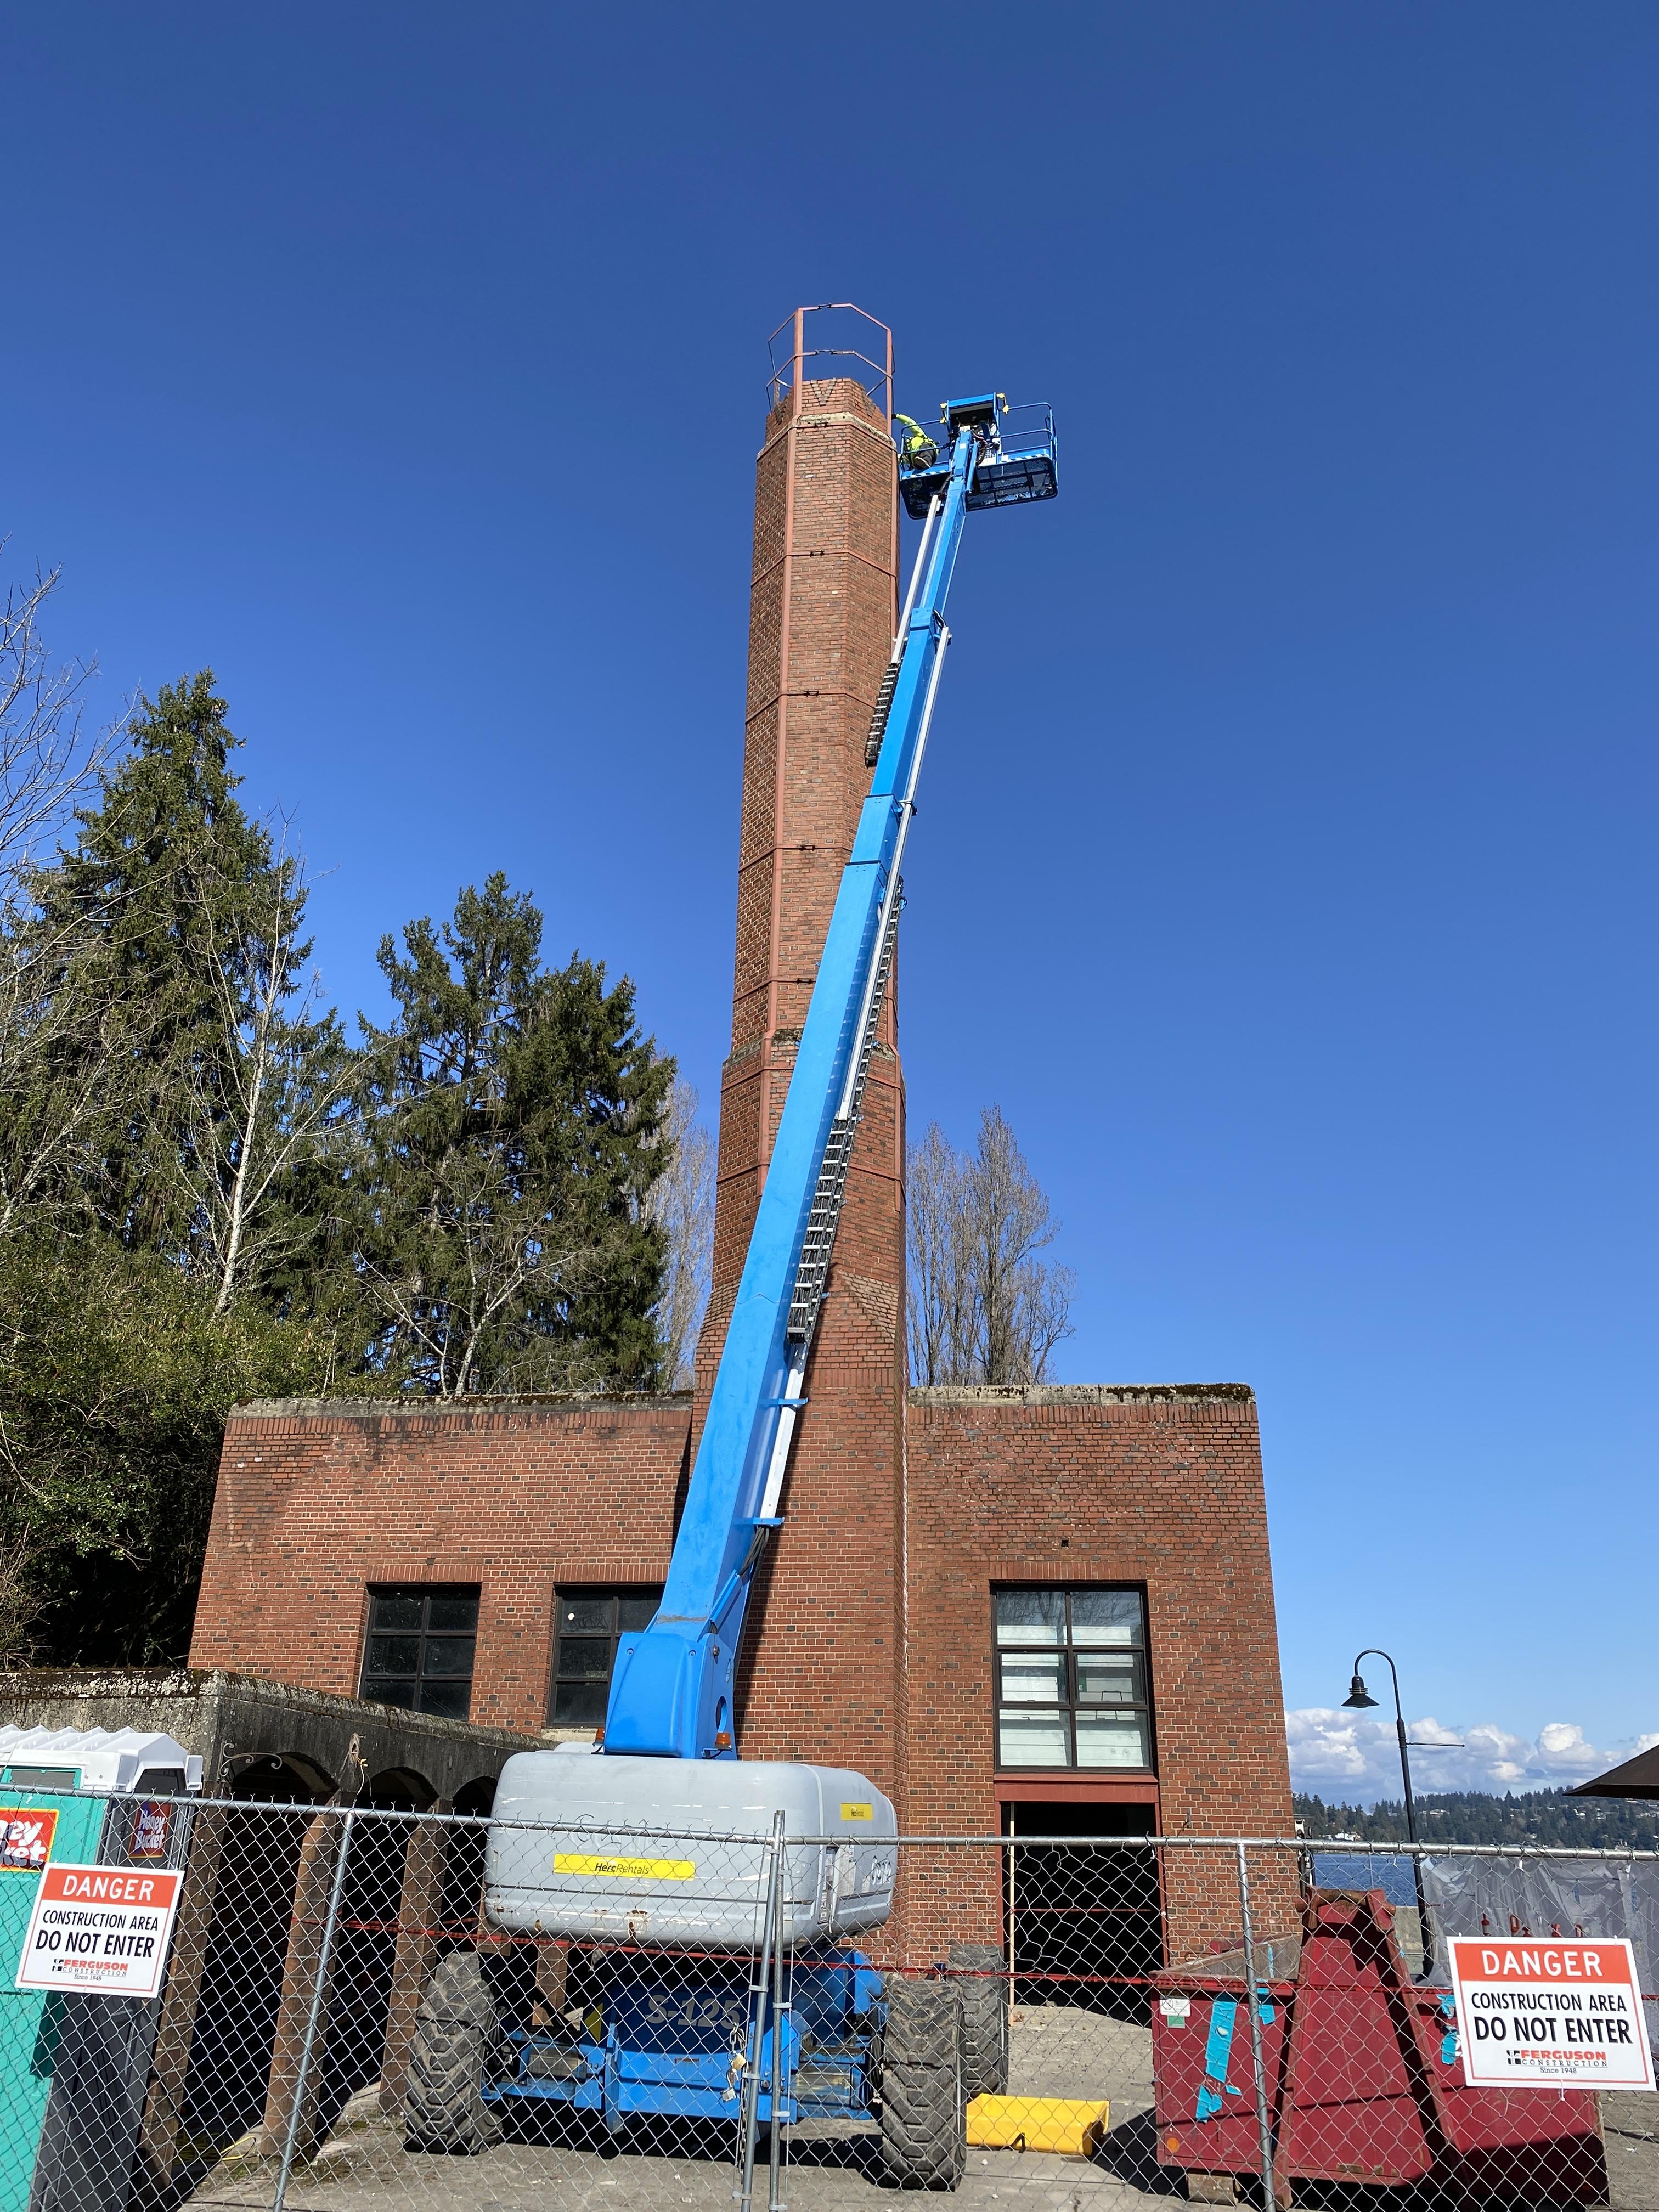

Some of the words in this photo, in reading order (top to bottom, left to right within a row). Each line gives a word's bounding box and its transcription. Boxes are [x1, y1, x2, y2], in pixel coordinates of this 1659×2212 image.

[138, 1809, 166, 1835] Honey
[134, 1830, 165, 1849] Bucket
[595, 1863, 649, 1875] HercRentals
[62, 1875, 154, 1901] DANGER
[43, 1910, 127, 1929] CONSTRUCTION
[129, 1916, 158, 1931] AREA
[36, 1929, 61, 1951] DO
[65, 1932, 101, 1954] NOT
[104, 1934, 155, 1958] ENTER
[63, 1959, 129, 1971] FERGUSON
[63, 1967, 127, 1976] CONSTRUCTION
[1481, 1950, 1604, 1977] DANGER
[645, 1994, 742, 2029] S-125
[1471, 1992, 1583, 2011] CONSTRUCTION
[1589, 1994, 1627, 2012] AREA
[1474, 2016, 1506, 2041] DO
[1514, 2017, 1557, 2042] NOT
[1565, 2018, 1633, 2044] ENTER
[1521, 2050, 1606, 2061] FERGUSON
